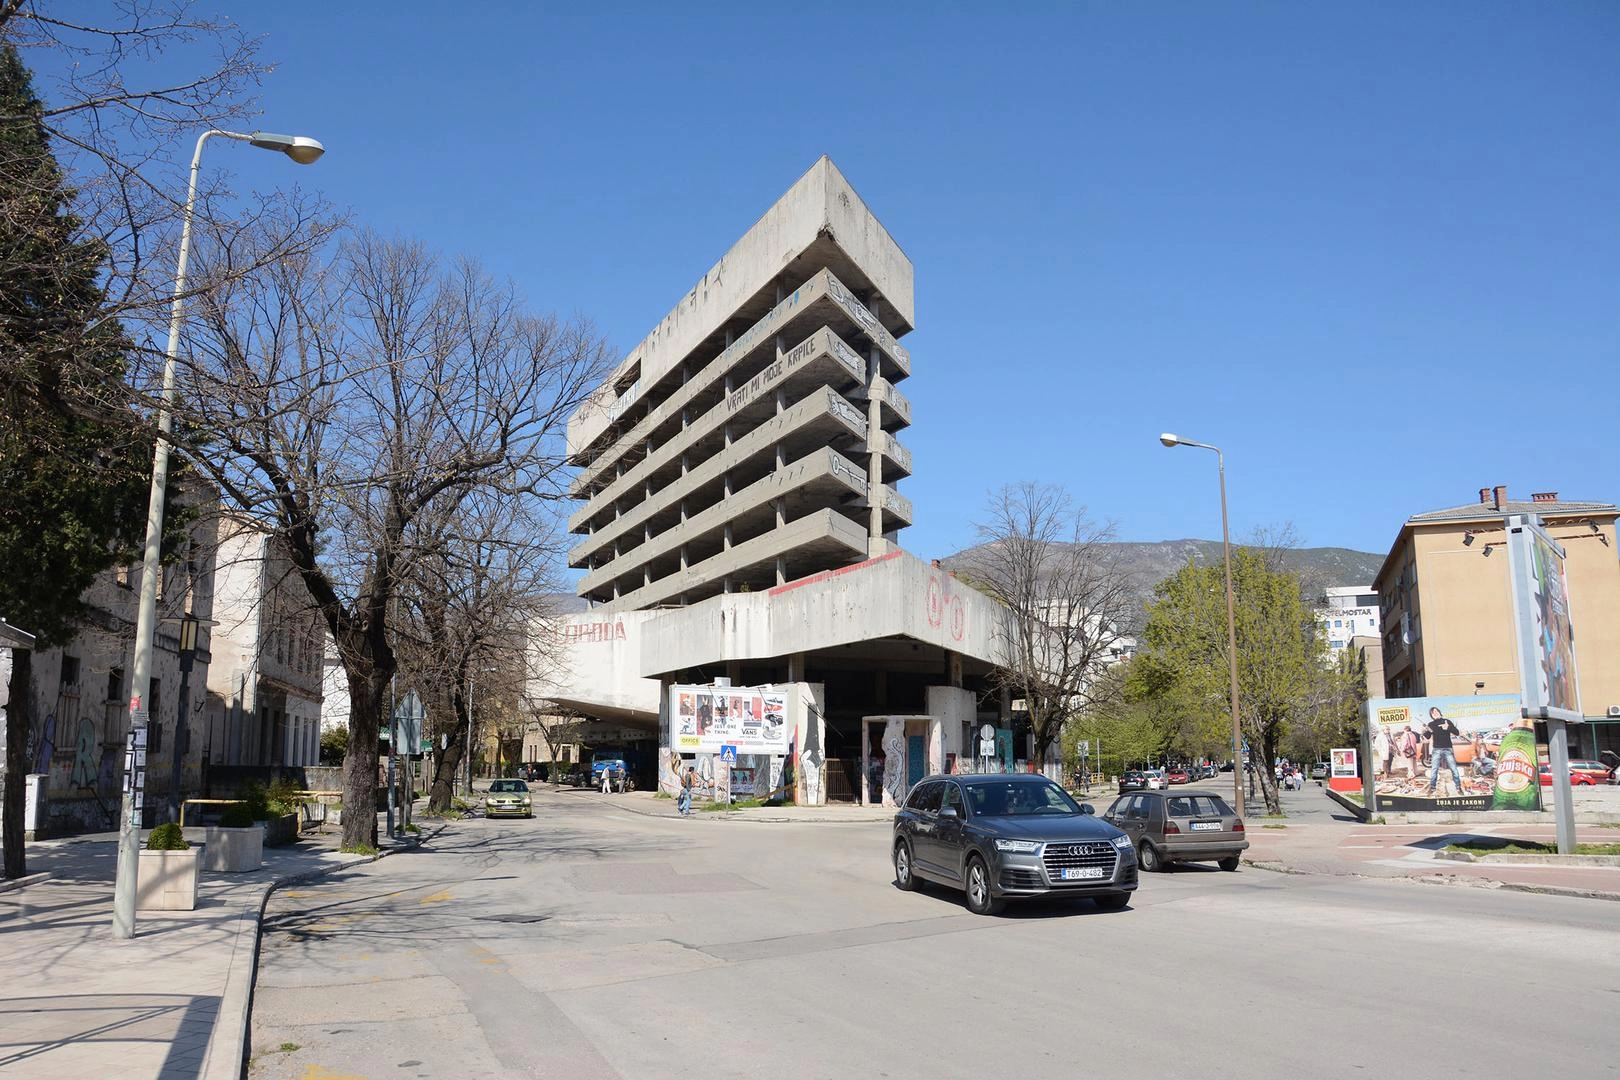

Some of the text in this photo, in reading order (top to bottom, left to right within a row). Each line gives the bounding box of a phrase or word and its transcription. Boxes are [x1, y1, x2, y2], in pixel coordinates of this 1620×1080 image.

[727, 338, 816, 411] VRATI MI MOJE KRPICE
